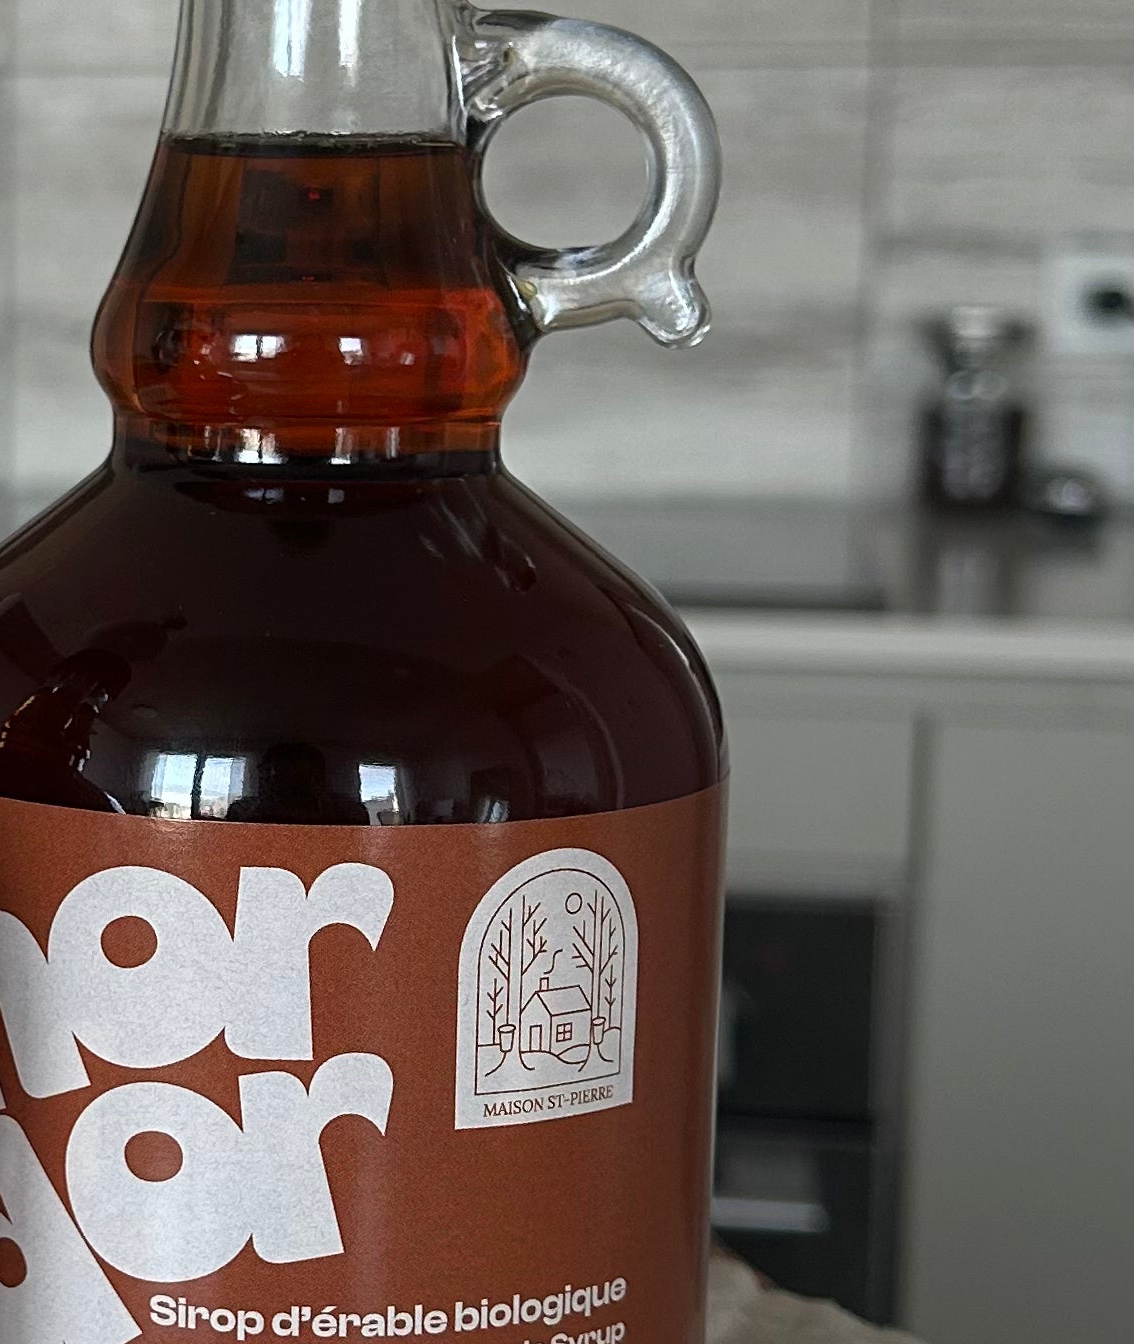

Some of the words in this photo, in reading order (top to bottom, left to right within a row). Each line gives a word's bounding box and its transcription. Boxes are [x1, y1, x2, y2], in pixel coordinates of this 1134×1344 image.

[483, 1097, 544, 1118] MAISON
[547, 1084, 614, 1110] ST-PIERRE
[149, 1293, 265, 1342] Sirop
[454, 1276, 627, 1334] biologique
